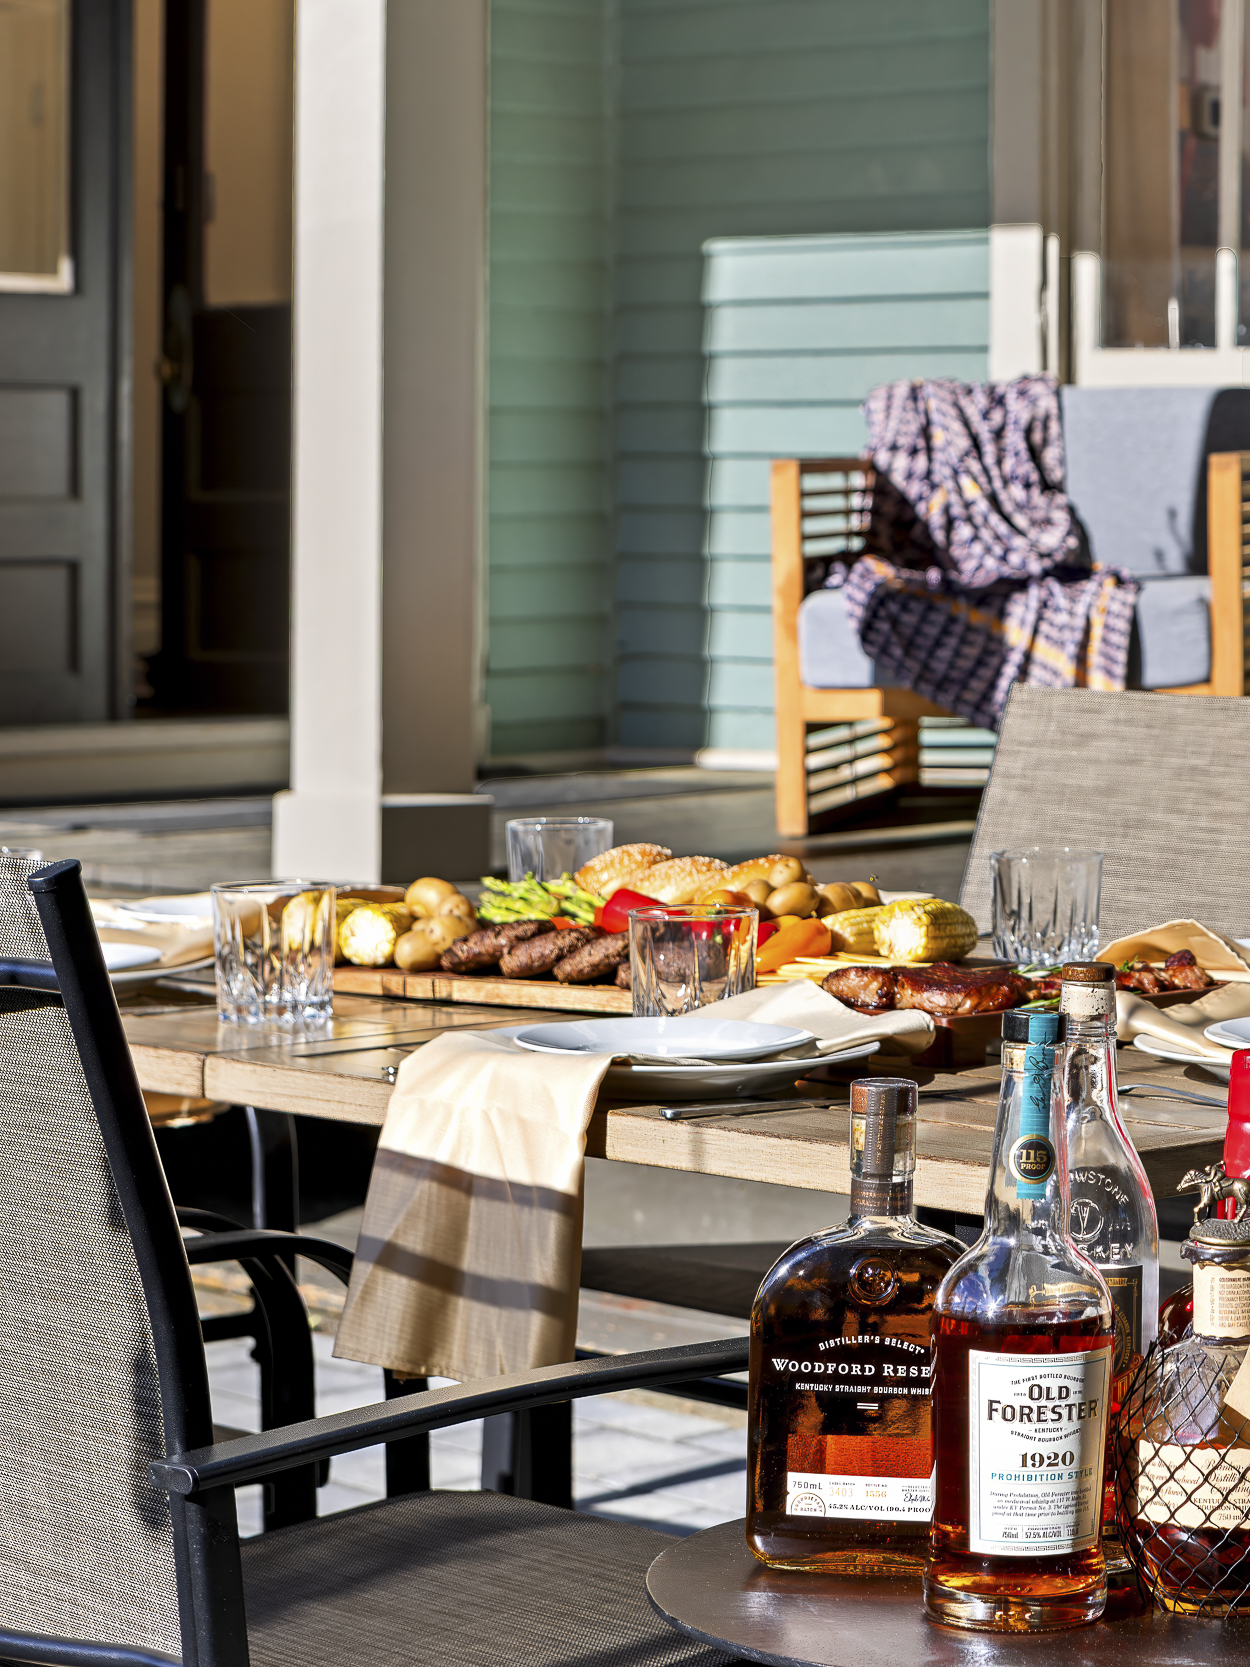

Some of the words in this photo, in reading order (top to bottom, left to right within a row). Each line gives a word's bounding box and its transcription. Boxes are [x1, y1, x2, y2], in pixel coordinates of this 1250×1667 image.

[1020, 1149, 1047, 1162] 115
[819, 1335, 880, 1351] DISTILLER'S
[772, 1358, 875, 1376] WOODFORD
[795, 1383, 833, 1392] KENTUCKY
[835, 1385, 871, 1393] STRAIGHT
[873, 1386, 908, 1395] BOURBON
[1029, 1384, 1071, 1402] OLD
[987, 1398, 1099, 1424] FORESTER
[1011, 1430, 1036, 1442] STRAIGHT
[1019, 1451, 1075, 1468] 1920
[991, 1473, 1063, 1481] PROHIBITION
[1068, 1467, 1093, 1479] STYLE
[793, 1481, 823, 1490] 750mL
[829, 1487, 854, 1497] 3403
[866, 1490, 887, 1498] 1556
